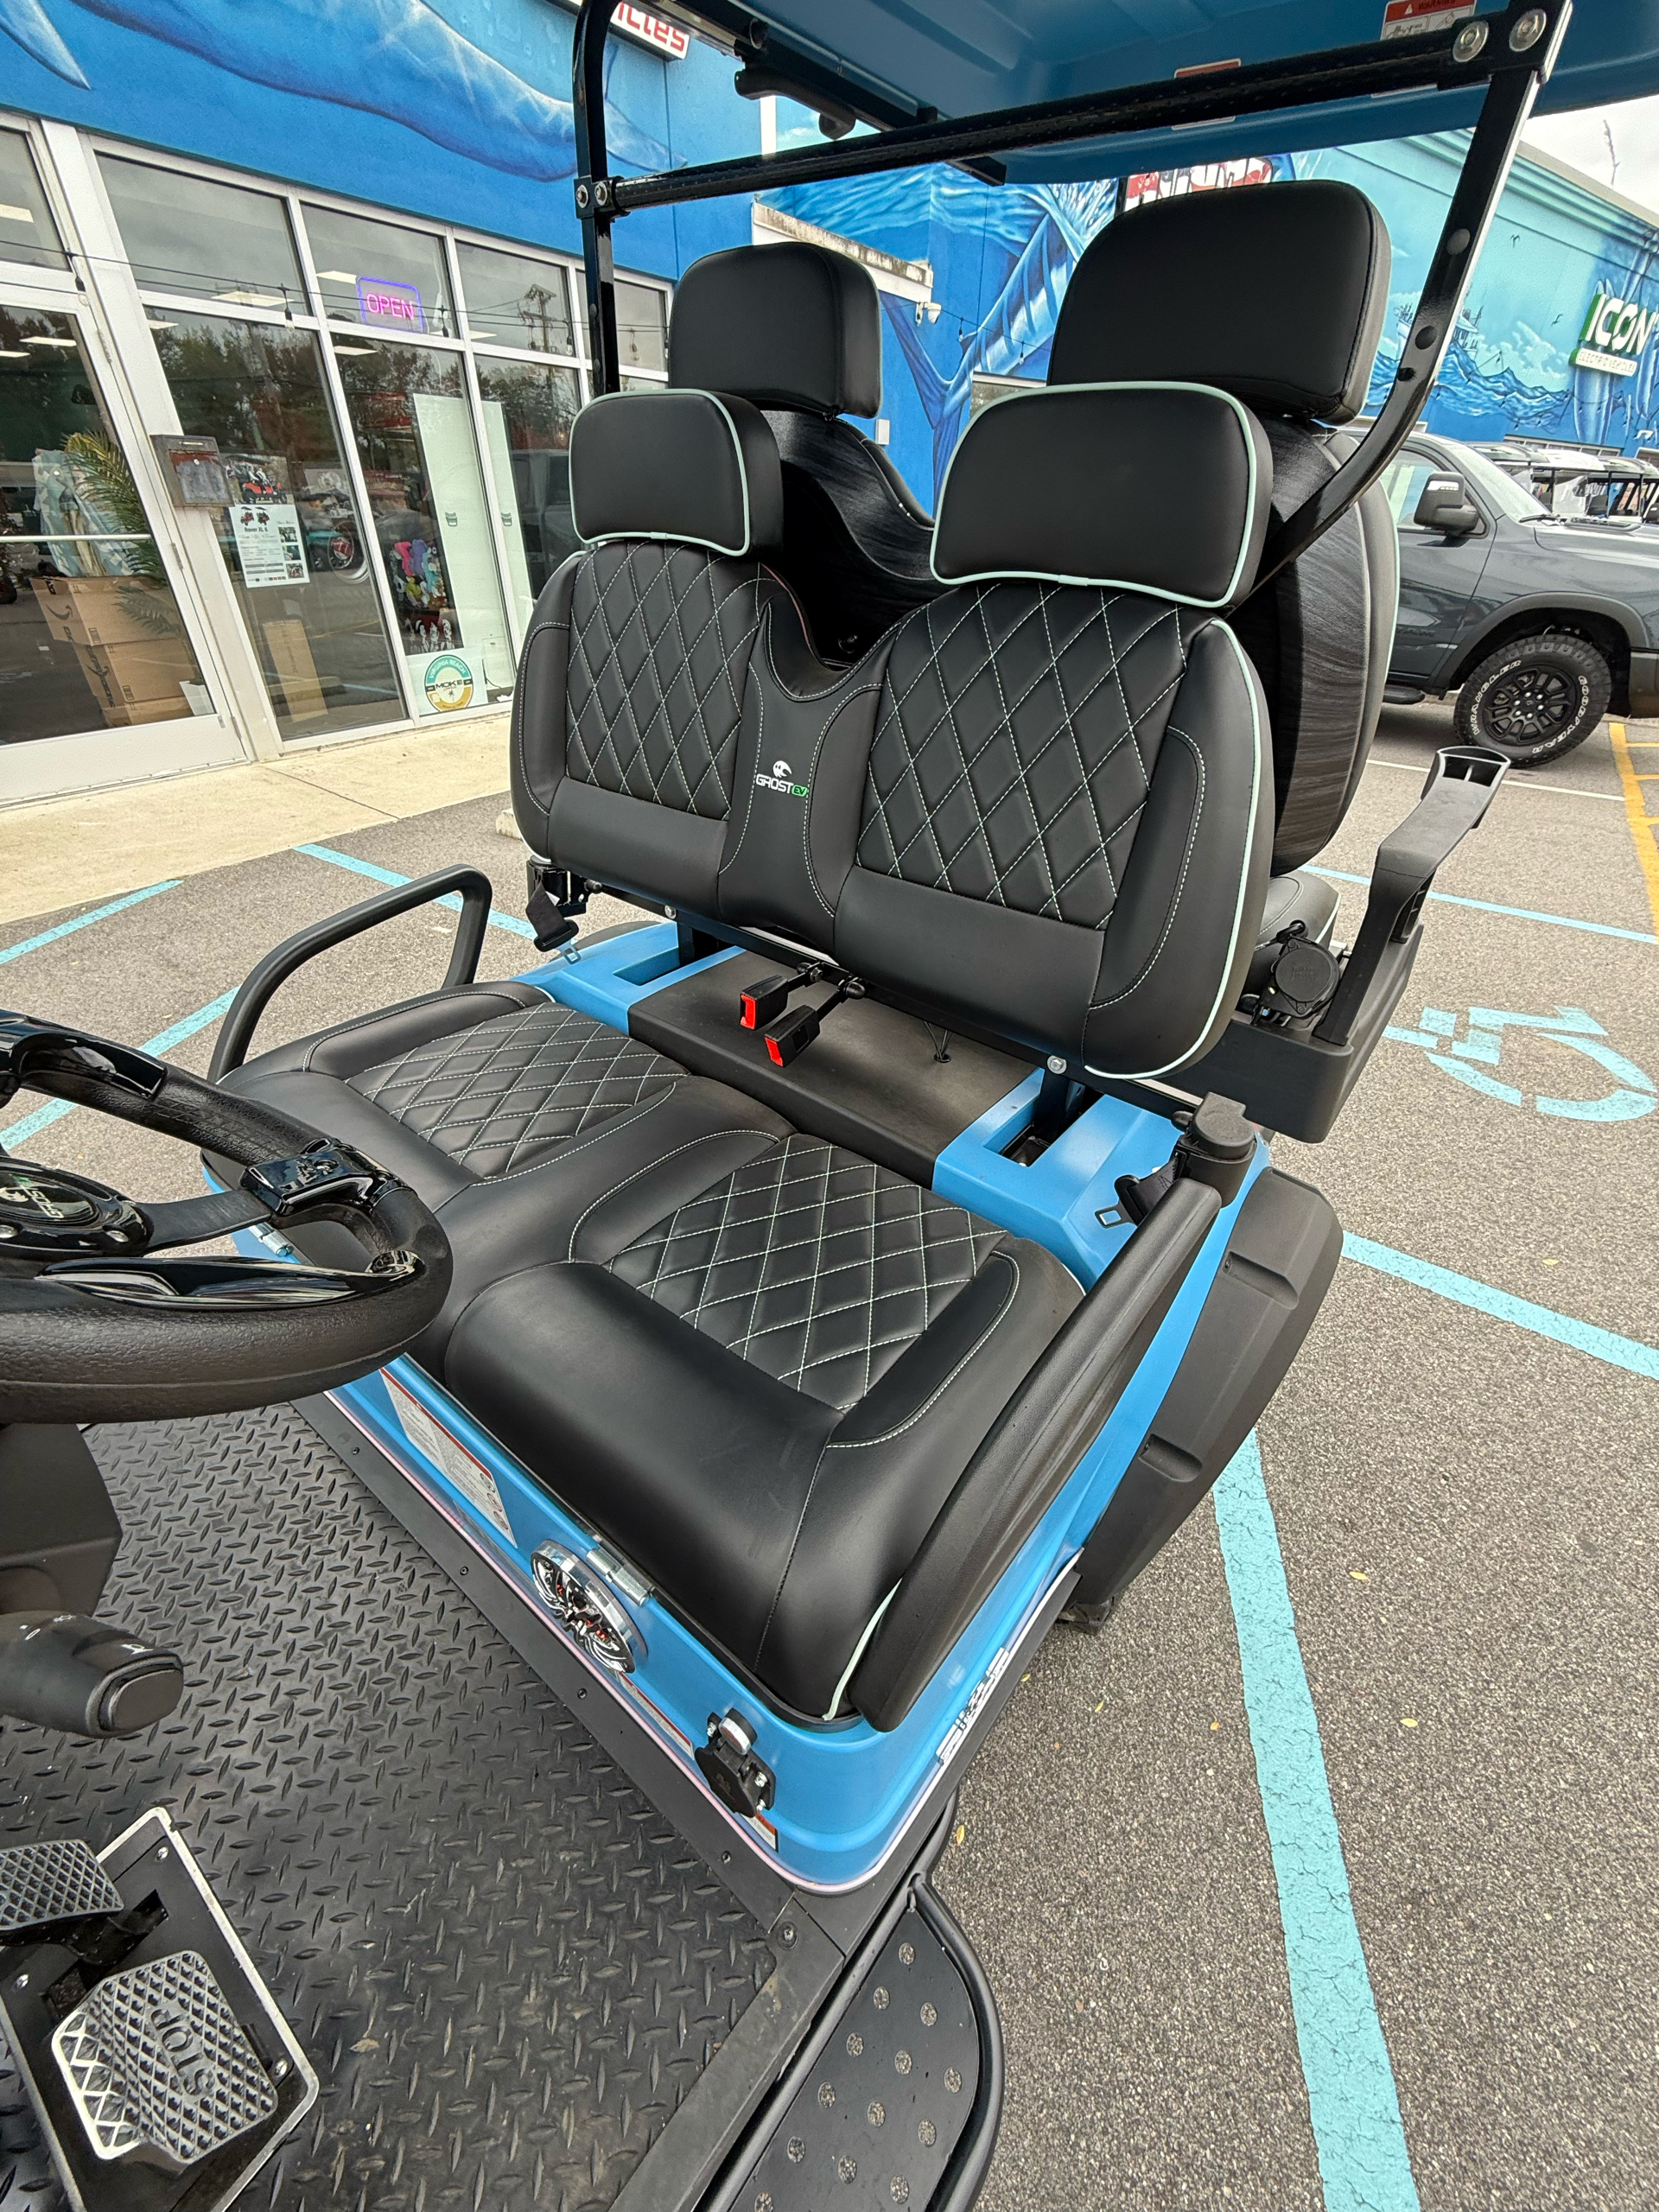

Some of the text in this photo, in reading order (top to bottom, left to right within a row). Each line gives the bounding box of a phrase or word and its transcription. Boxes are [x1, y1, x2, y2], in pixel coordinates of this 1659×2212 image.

[366, 292, 415, 321] OPEN
[1585, 293, 1657, 356] ICON
[429, 659, 467, 679] VIRGINIA BEACH
[435, 679, 463, 689] MOKE
[1471, 660, 1522, 735] WRANGLER
[755, 773, 806, 796] GHOST EV
[150, 2008, 216, 2096] STOP
